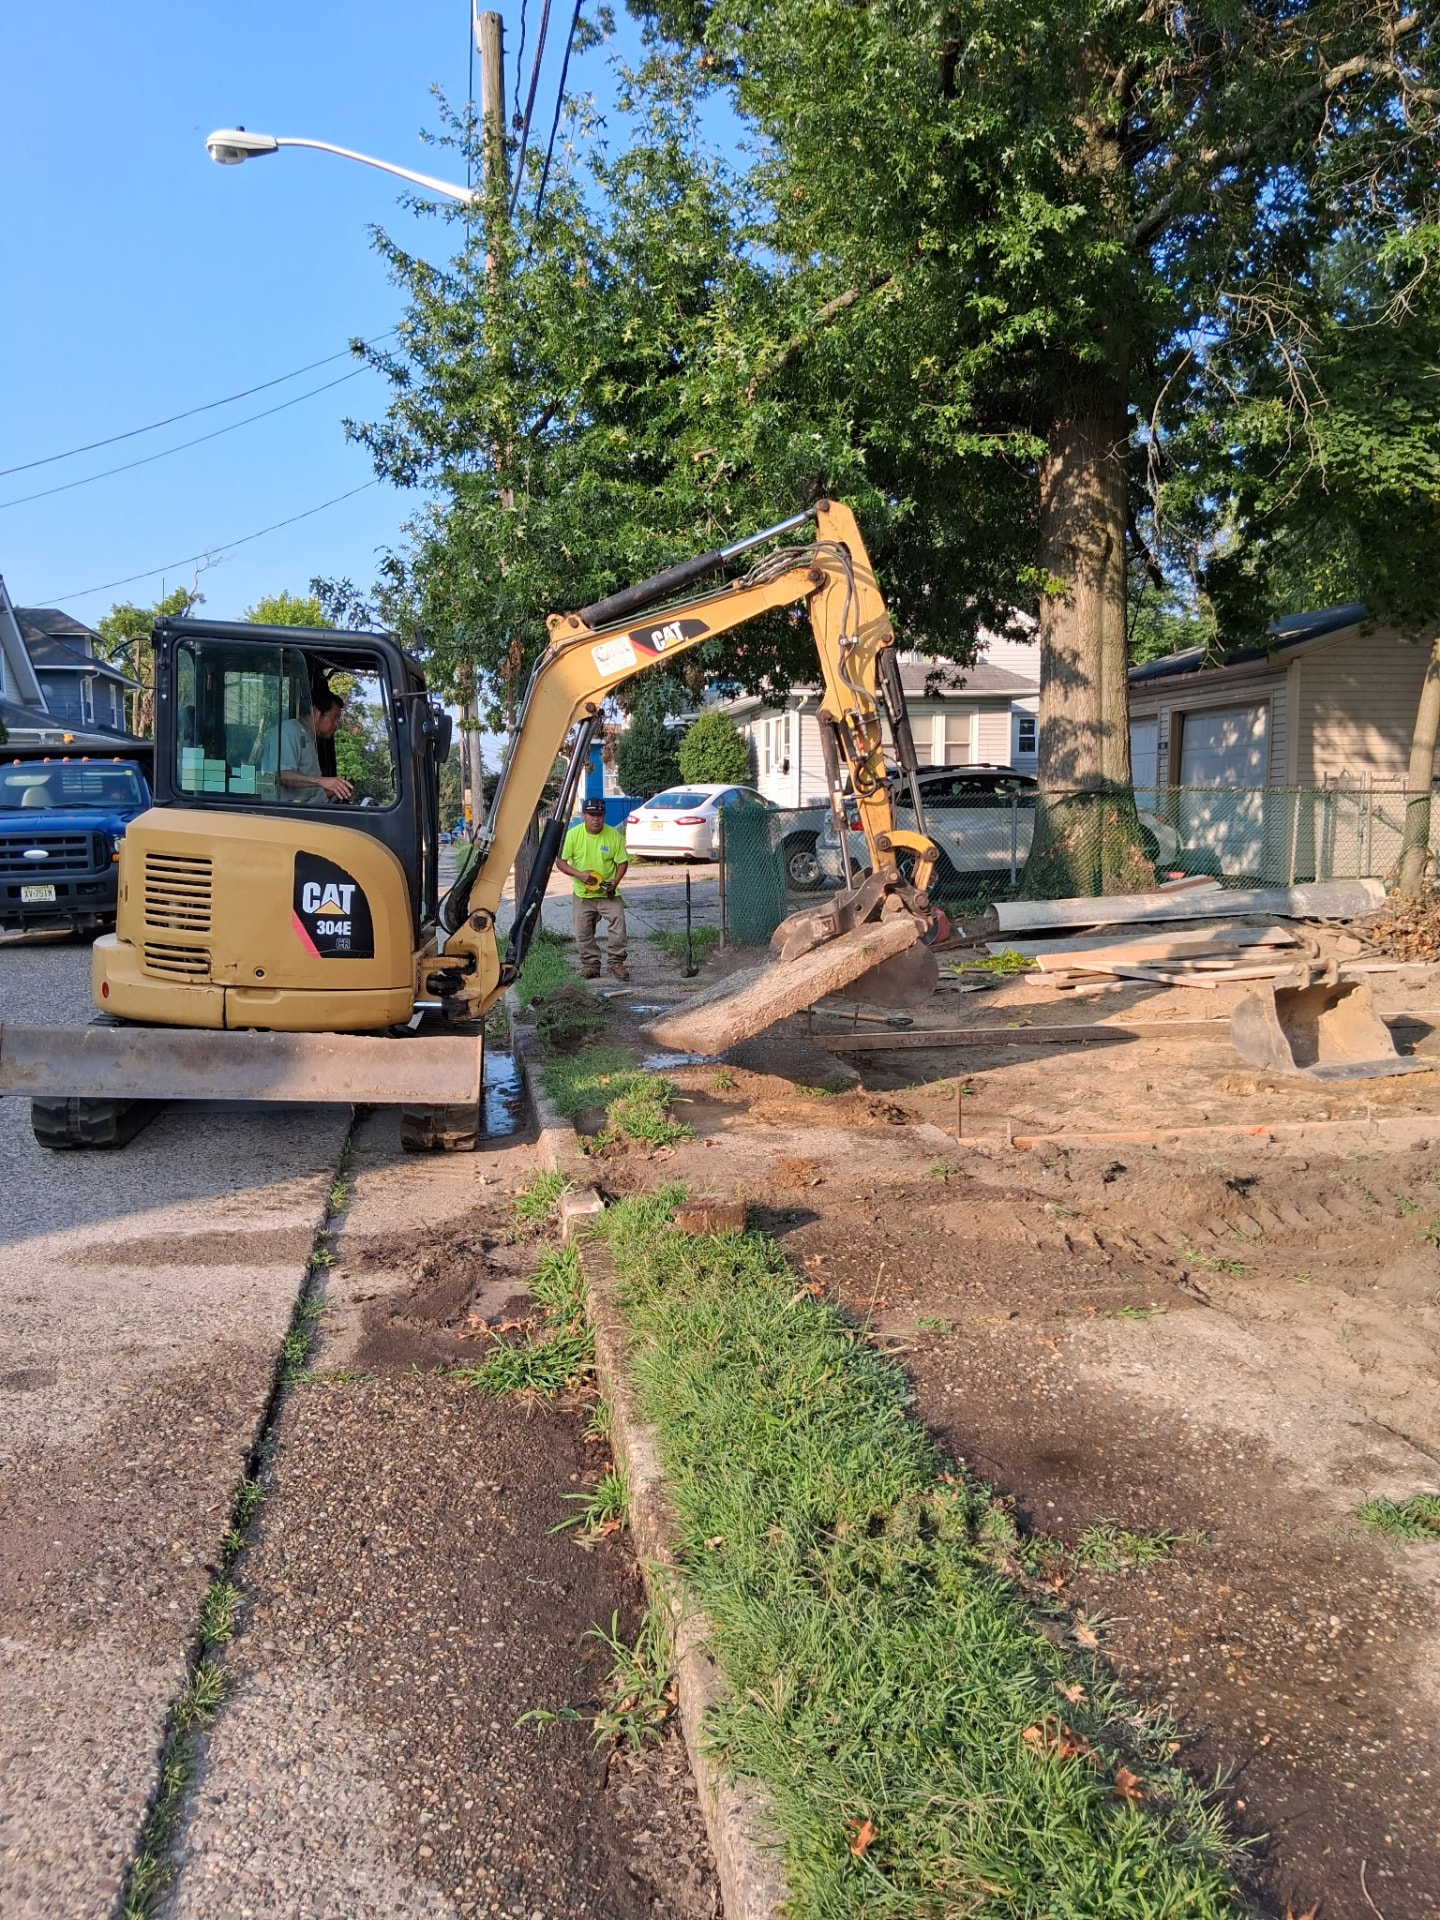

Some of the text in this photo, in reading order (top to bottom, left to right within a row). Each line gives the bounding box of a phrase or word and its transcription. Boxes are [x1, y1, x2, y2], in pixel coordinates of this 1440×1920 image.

[651, 621, 684, 651] CAT
[302, 882, 356, 915] CAT
[316, 920, 352, 935] 304E
[335, 937, 351, 950] CR
